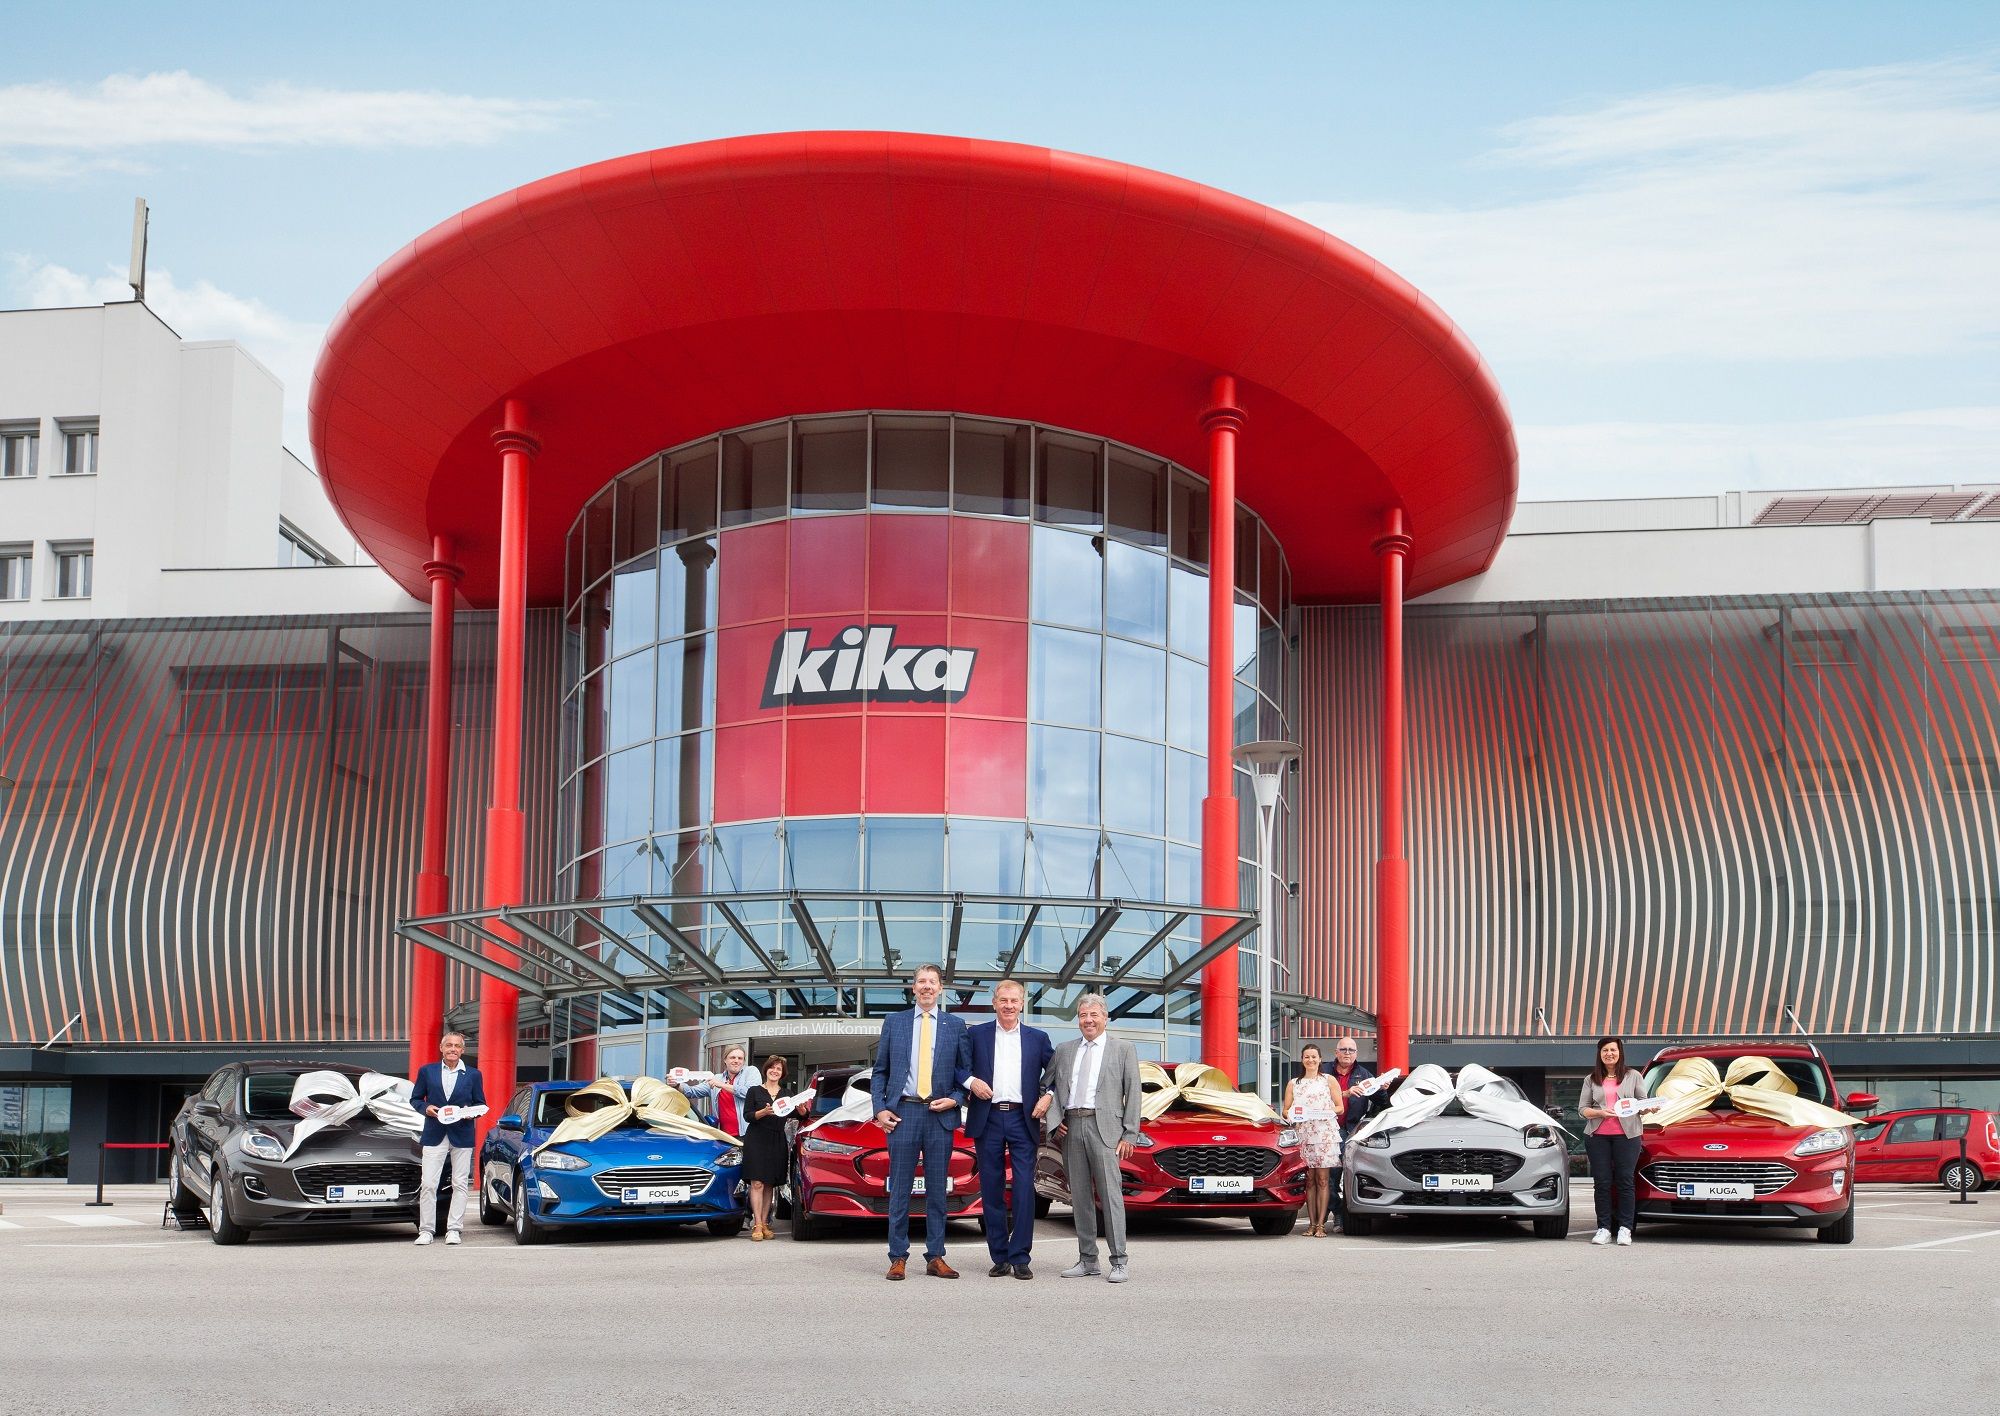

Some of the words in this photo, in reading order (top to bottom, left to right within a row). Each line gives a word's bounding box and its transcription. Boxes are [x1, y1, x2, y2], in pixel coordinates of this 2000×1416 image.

[771, 626, 975, 697] kika
[758, 1023, 808, 1036] Herzlich
[1217, 1180, 1241, 1188] KUGA
[1451, 1178, 1480, 1186] PUMA
[357, 1188, 386, 1196] PUMA
[648, 1190, 680, 1198] FOCUS
[1709, 1187, 1738, 1195] KUGA
